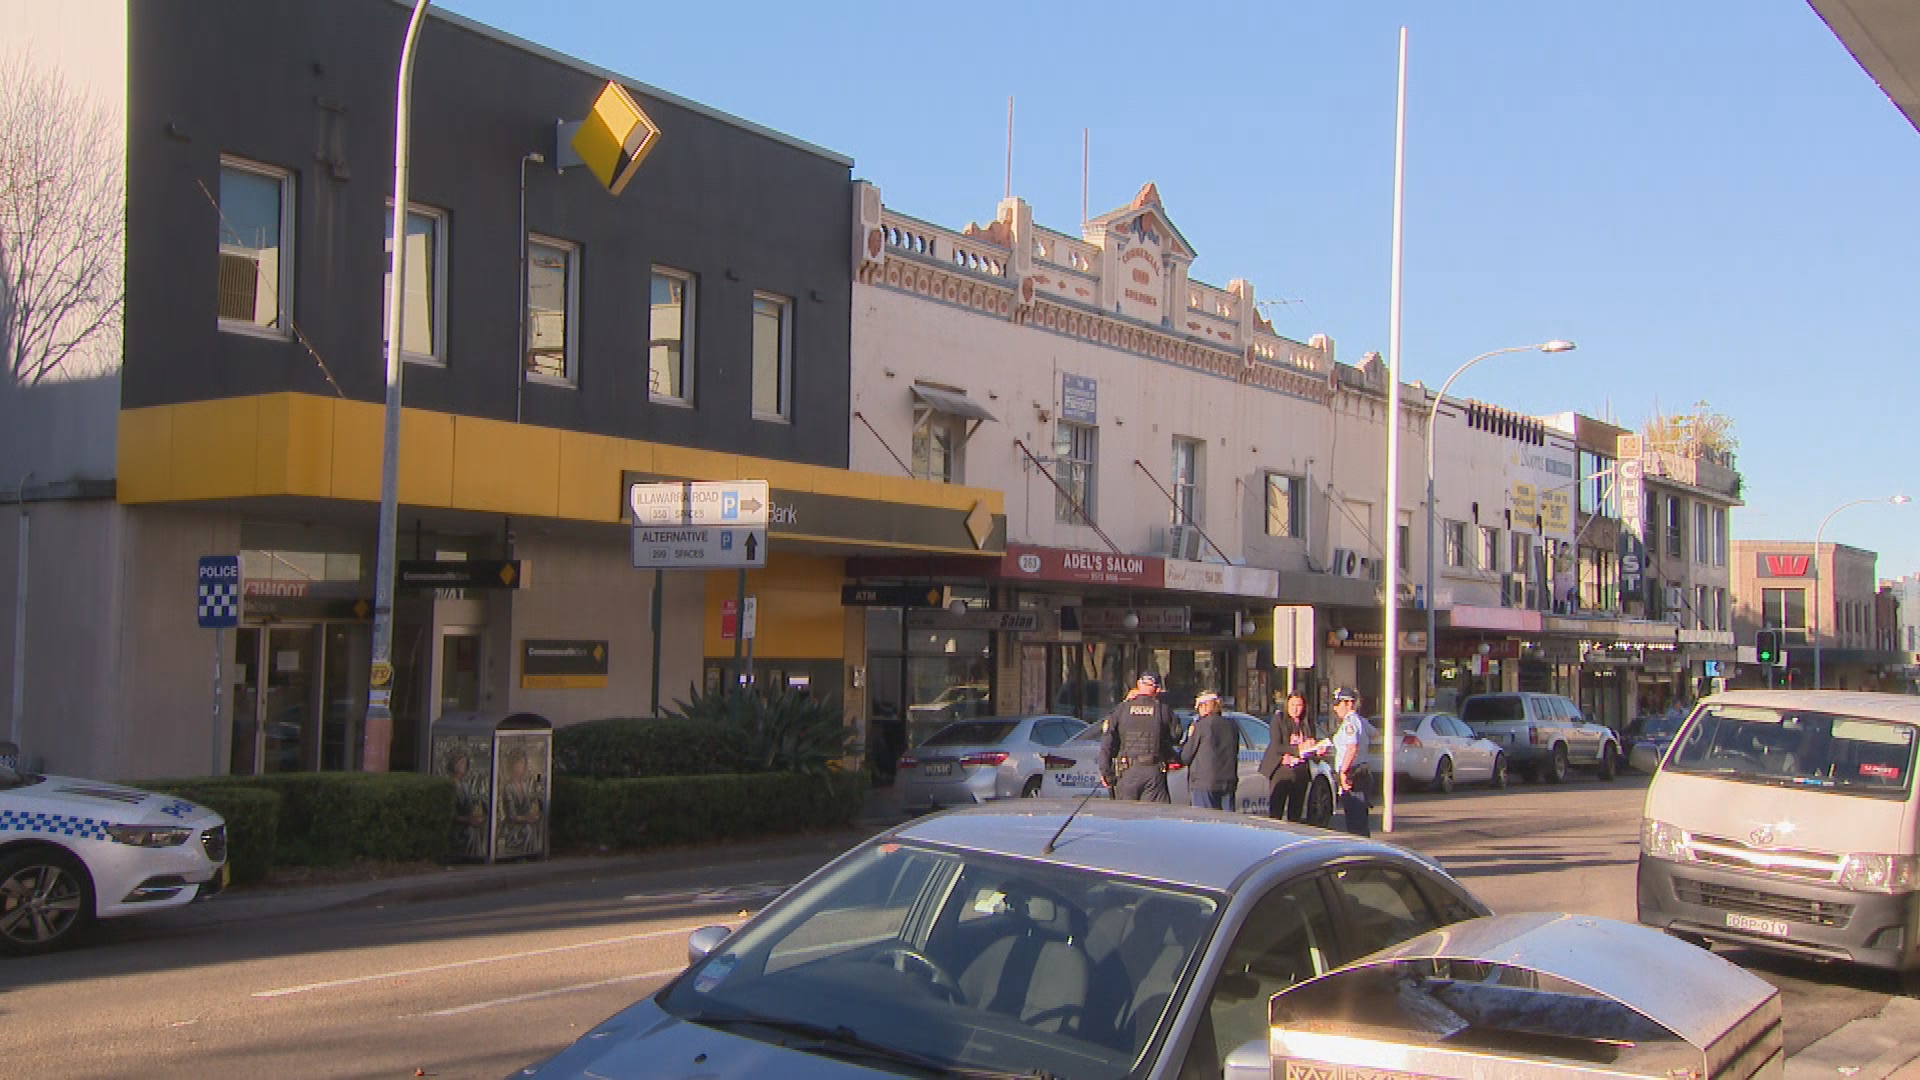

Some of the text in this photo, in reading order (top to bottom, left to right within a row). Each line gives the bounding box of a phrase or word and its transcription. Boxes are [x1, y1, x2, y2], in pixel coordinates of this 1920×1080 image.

[637, 491, 689, 504] ILLAWARRA
[691, 490, 719, 503] ROAD
[674, 549, 705, 559] SPACES
[1063, 554, 1143, 573] ADEL'S SALON
[199, 565, 238, 578] POLICE
[855, 591, 877, 601] ATM
[1129, 706, 1155, 716] POLICE
